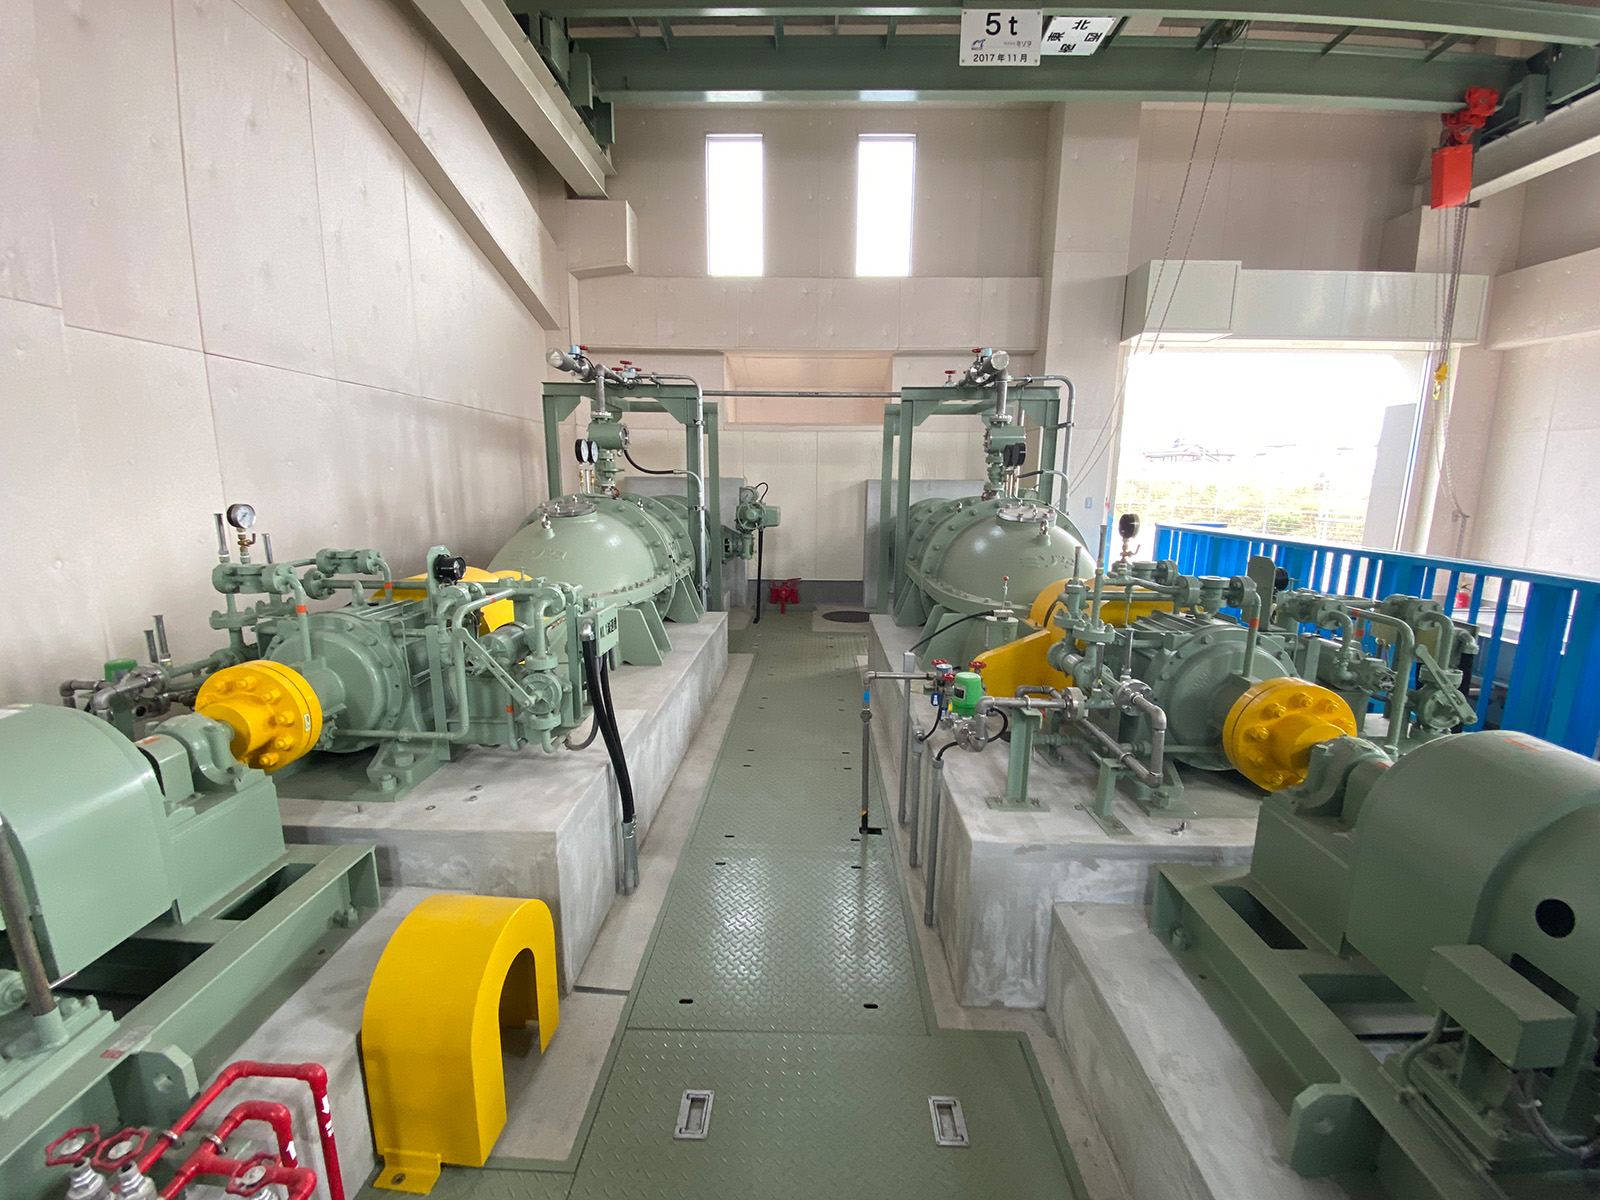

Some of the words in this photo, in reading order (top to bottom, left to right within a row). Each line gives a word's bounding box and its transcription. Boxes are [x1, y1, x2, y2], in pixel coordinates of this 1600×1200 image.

[1071, 19, 1091, 30] 北
[1046, 31, 1066, 42] 東
[1083, 32, 1103, 42] 西
[1057, 43, 1077, 53] 南
